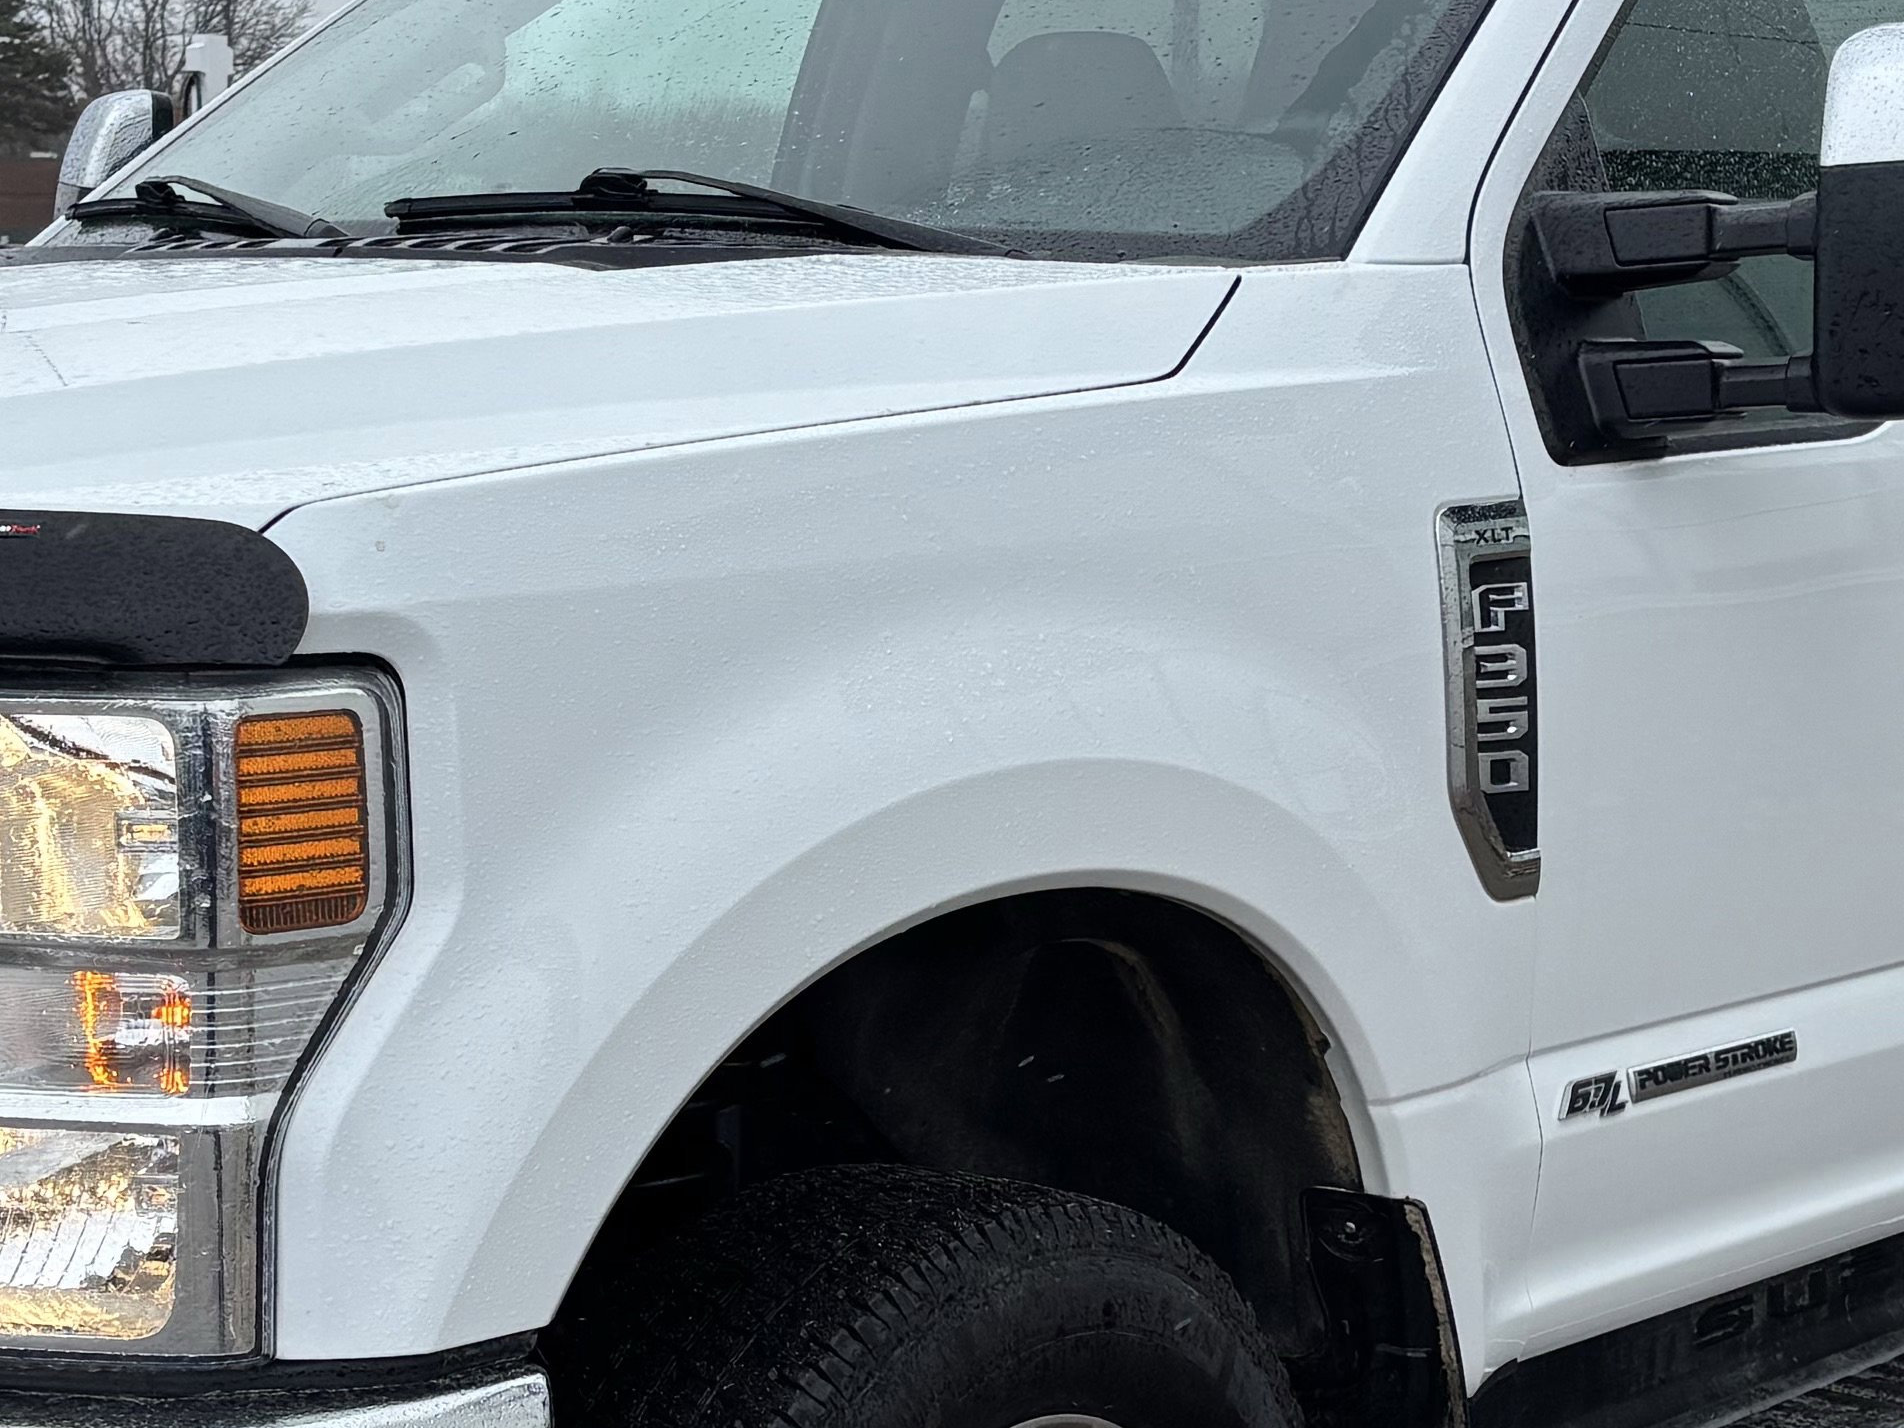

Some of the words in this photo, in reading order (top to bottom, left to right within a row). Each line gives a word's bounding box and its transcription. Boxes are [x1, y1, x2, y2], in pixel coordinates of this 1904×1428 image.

[1475, 526, 1514, 544] XLT
[1636, 1052, 1711, 1090] POWER
[1713, 1032, 1795, 1070] STROKE
